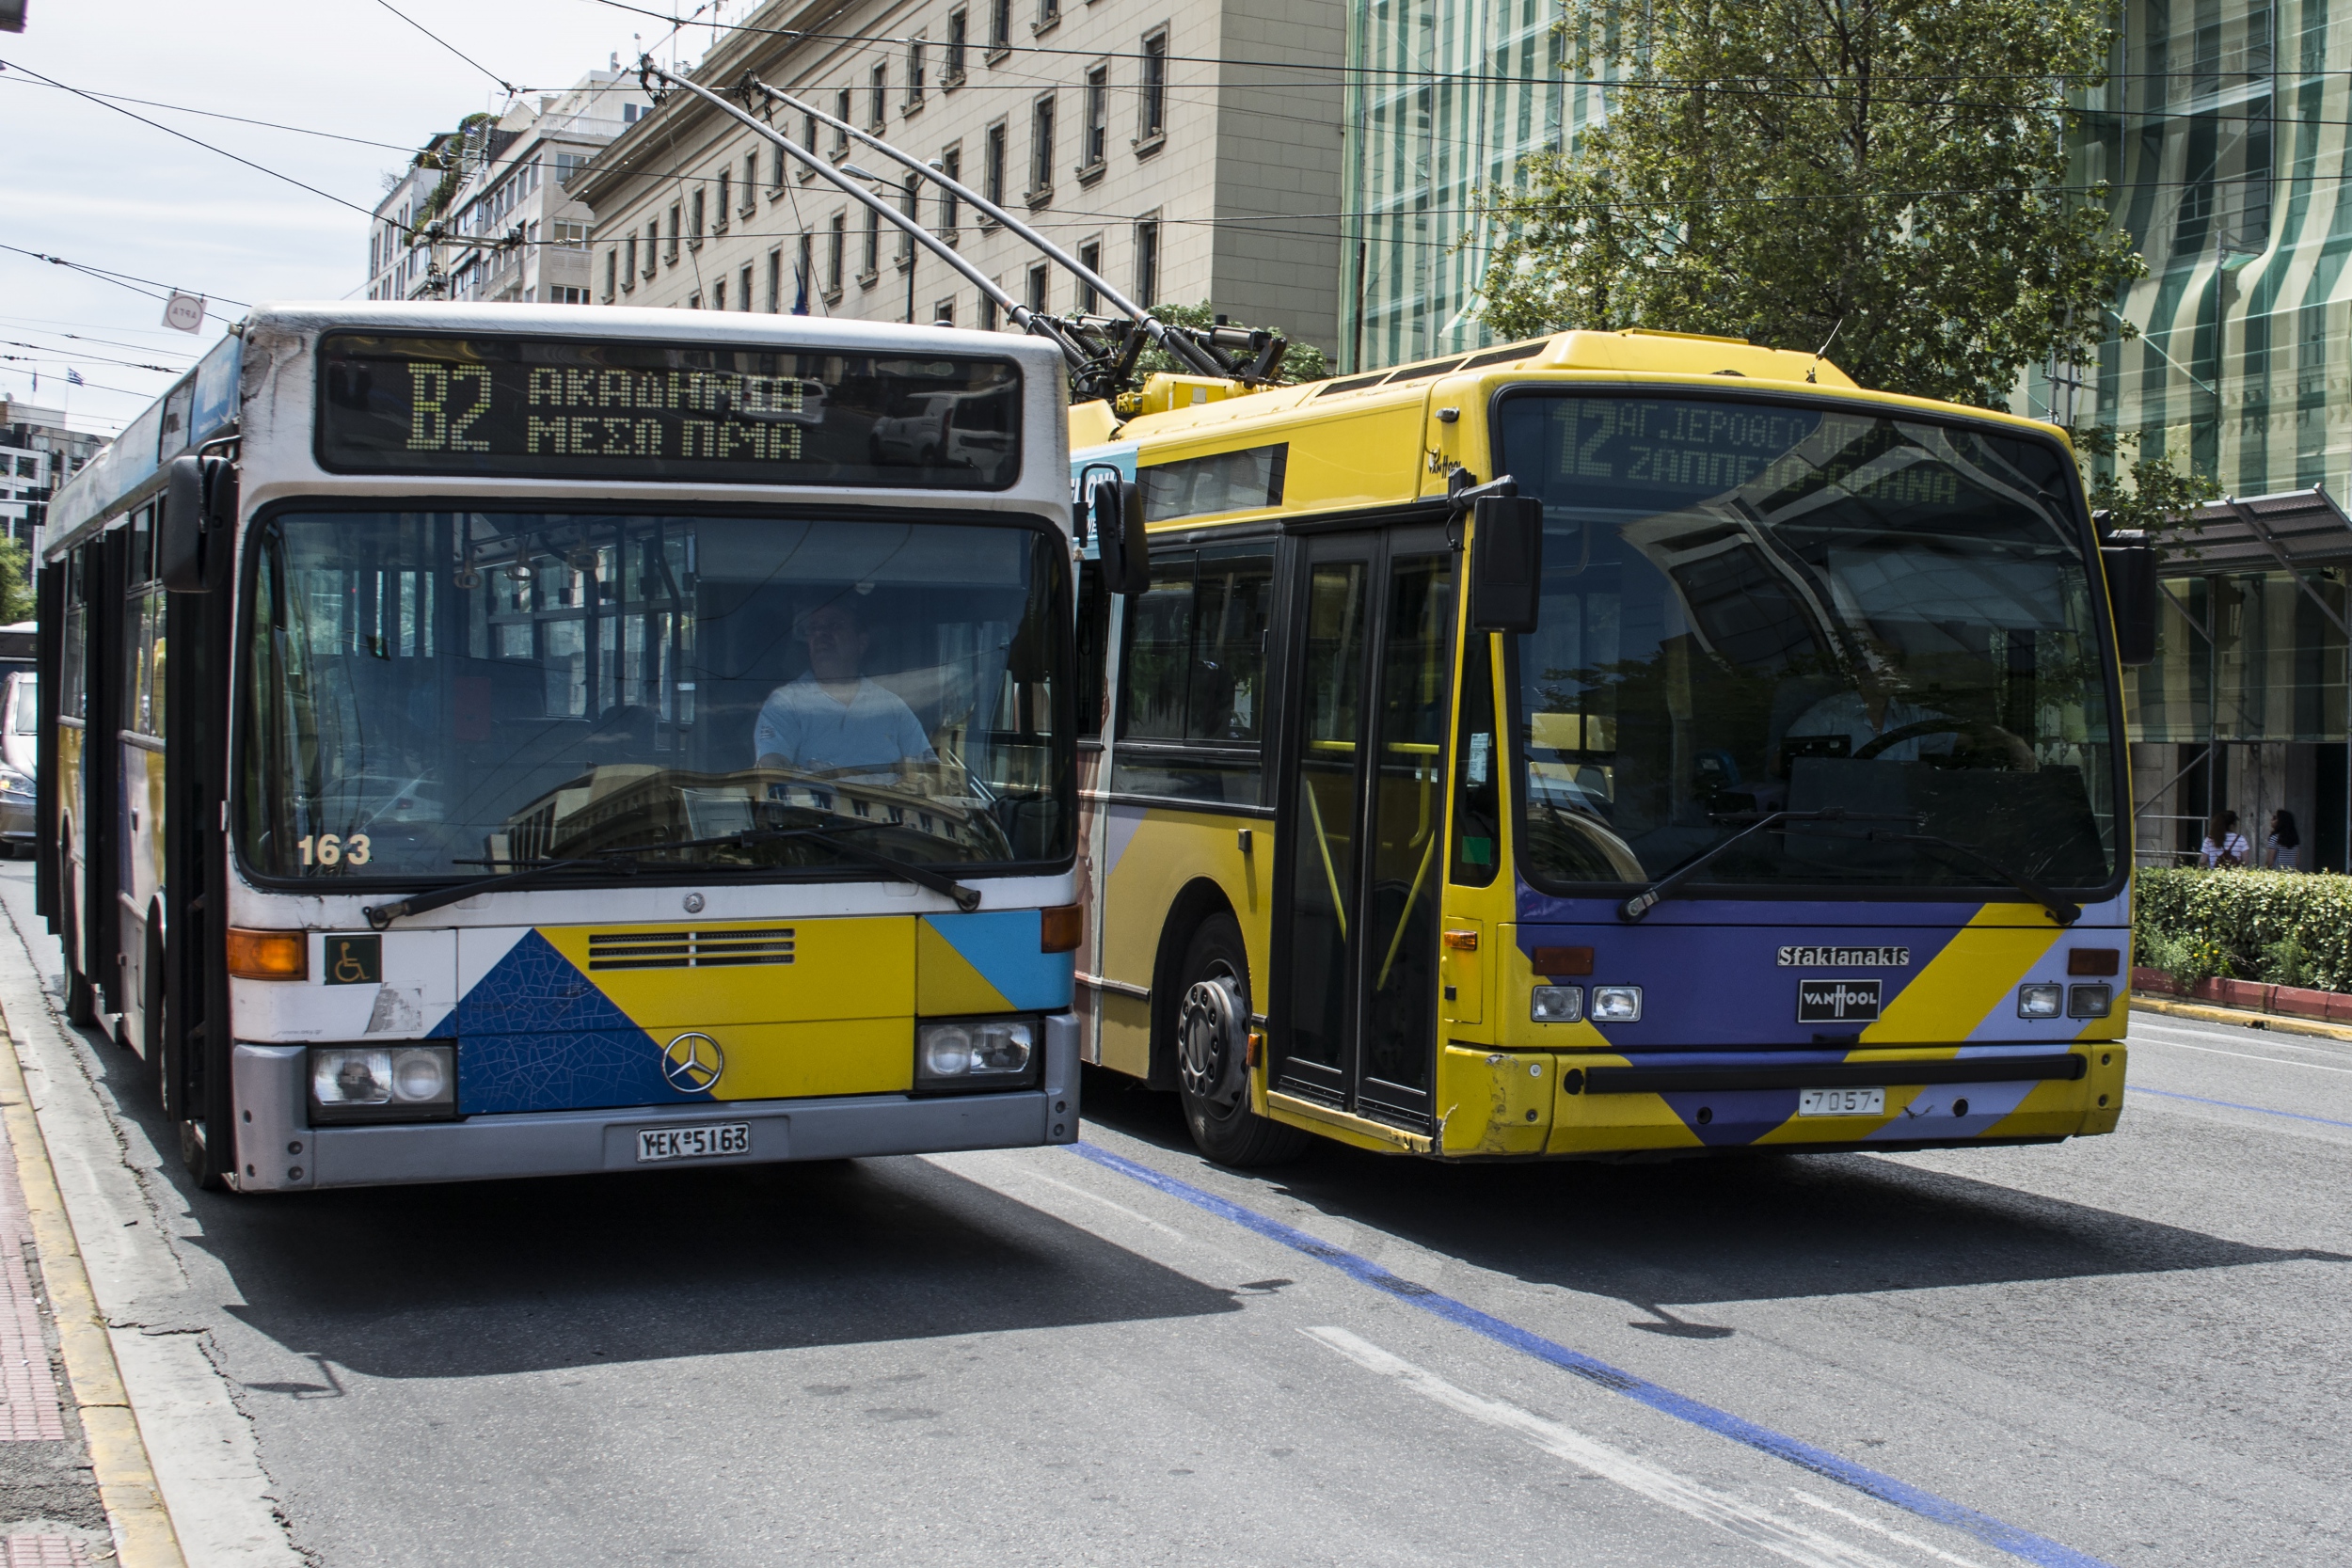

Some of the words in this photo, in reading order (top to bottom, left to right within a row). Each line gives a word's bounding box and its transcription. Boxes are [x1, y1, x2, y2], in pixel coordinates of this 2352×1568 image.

[1551, 397, 1617, 477] 12
[297, 833, 372, 865] 163
[1778, 947, 1909, 965] Sfakianakis
[1810, 1091, 1872, 1112] 7057
